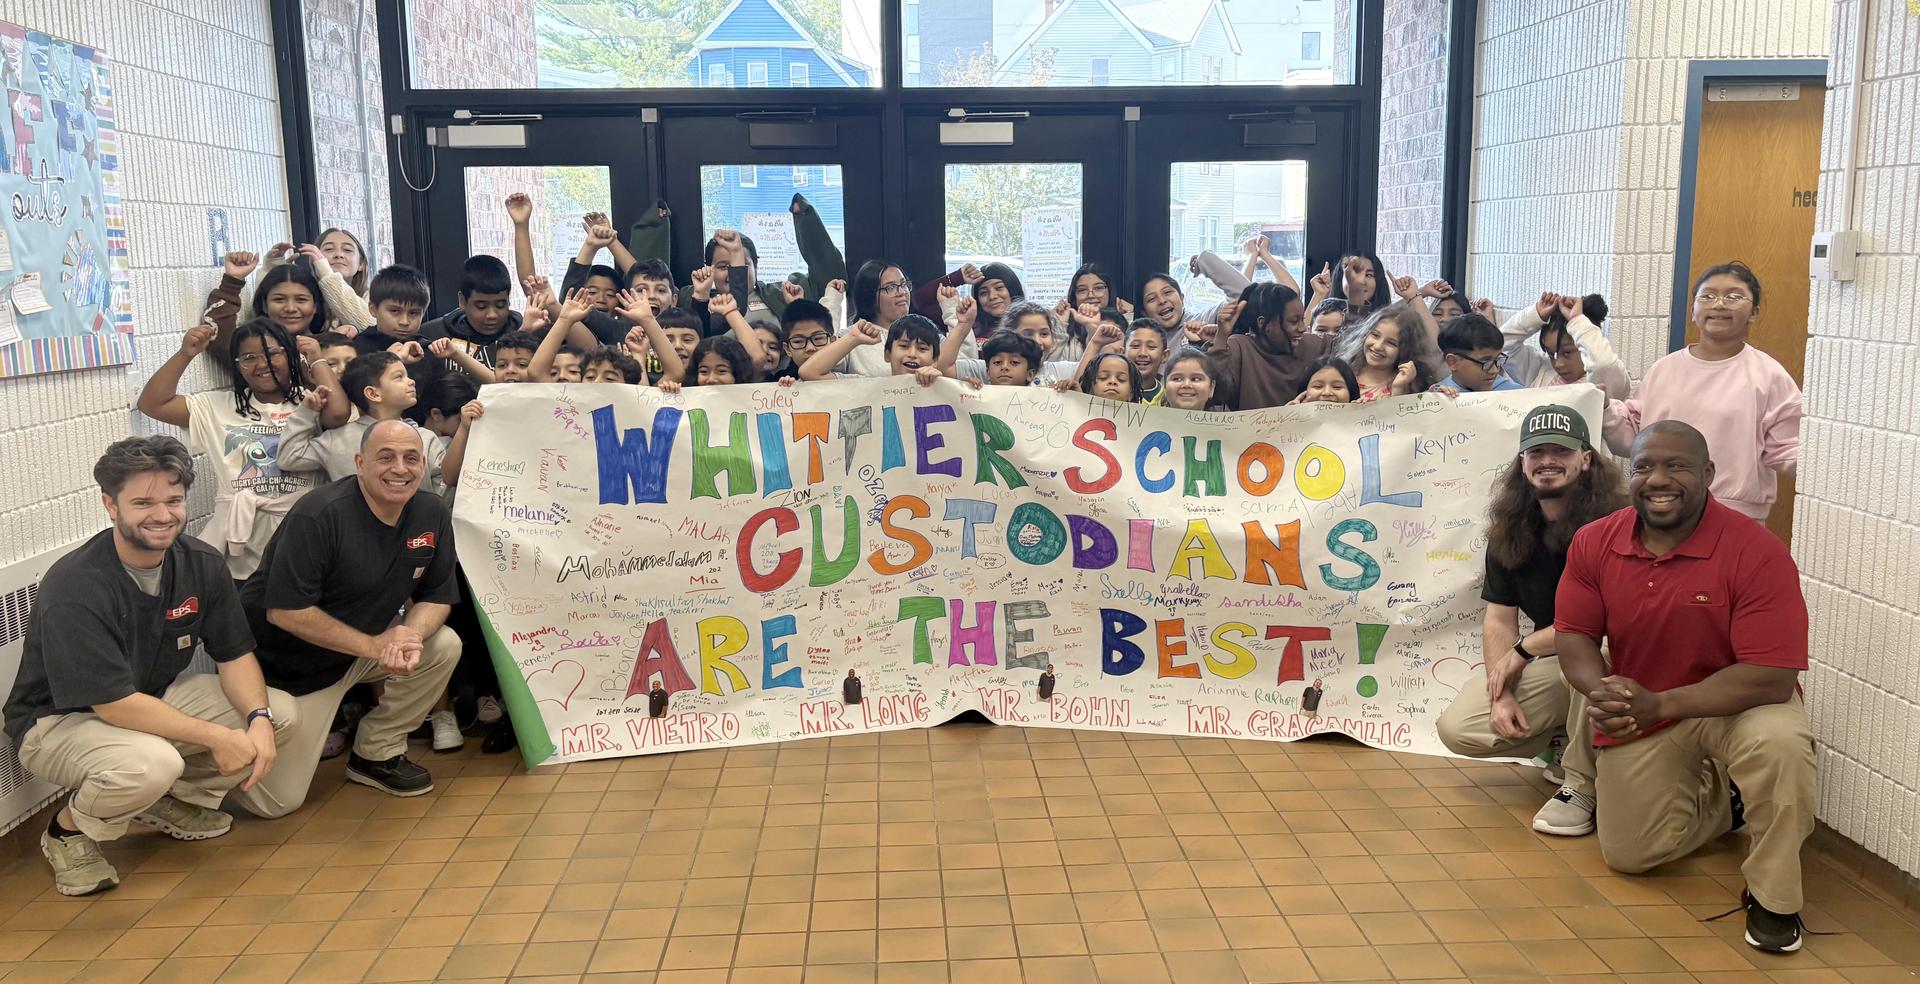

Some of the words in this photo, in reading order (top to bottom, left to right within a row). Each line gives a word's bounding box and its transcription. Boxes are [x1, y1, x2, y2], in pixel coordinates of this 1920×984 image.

[1398, 400, 1441, 413] Fatima
[1529, 412, 1571, 433] CELTICS
[589, 403, 1030, 506] WHITTIER
[1063, 418, 1423, 507] SCHOOL
[412, 537, 428, 547] EPS
[735, 494, 1382, 594] CUSTODIANS
[690, 575, 719, 585] Mia
[172, 604, 191, 617] EPS
[622, 615, 805, 705] ARE
[897, 596, 1052, 671] THE
[1099, 607, 1389, 698] BEST!
[799, 699, 855, 735] MR.
[860, 691, 931, 730] LONG
[978, 686, 1030, 723] MR.
[1049, 692, 1131, 728] BOHN
[1188, 704, 1242, 736] MR.
[560, 722, 623, 757] MR.
[625, 711, 740, 750] VIETRO
